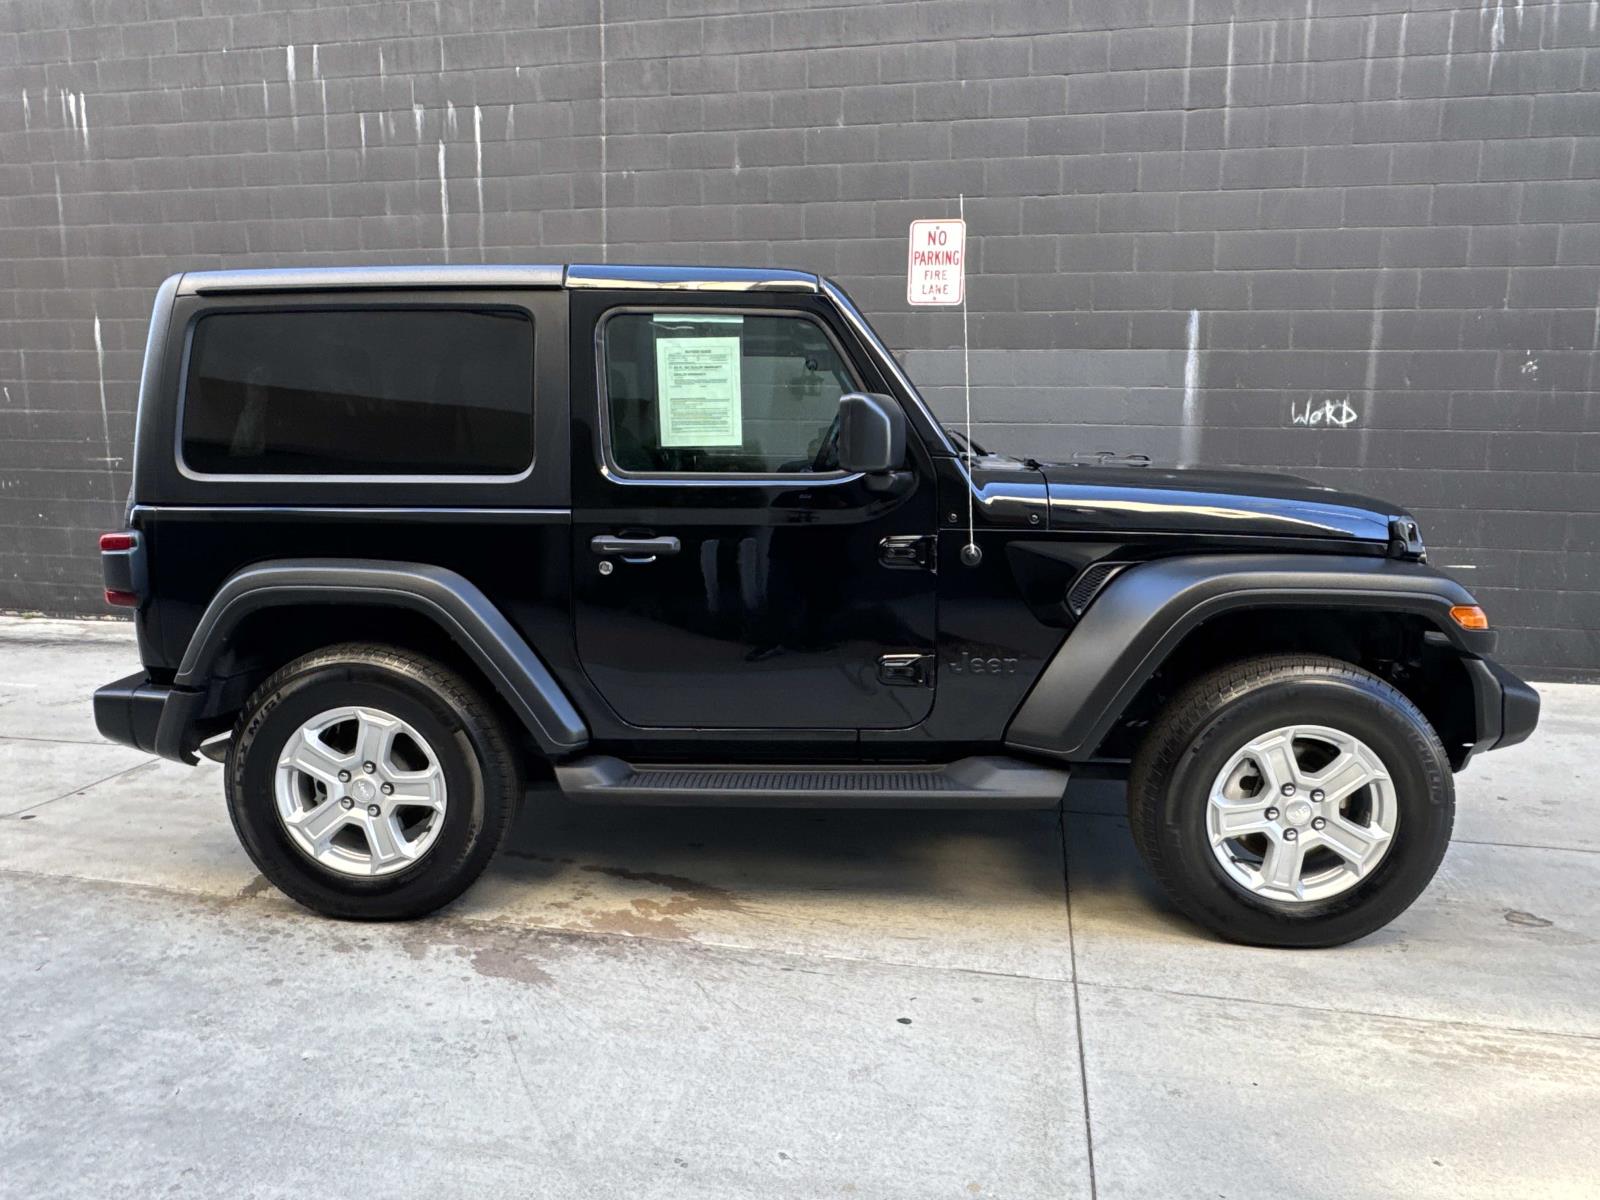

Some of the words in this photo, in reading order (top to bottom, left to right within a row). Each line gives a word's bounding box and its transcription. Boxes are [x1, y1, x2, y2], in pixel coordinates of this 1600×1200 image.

[928, 230, 947, 246] NO
[914, 251, 959, 265] PARKING
[924, 270, 948, 280] FIRE
[922, 284, 949, 295] LANE
[949, 651, 1018, 675] Jeep
